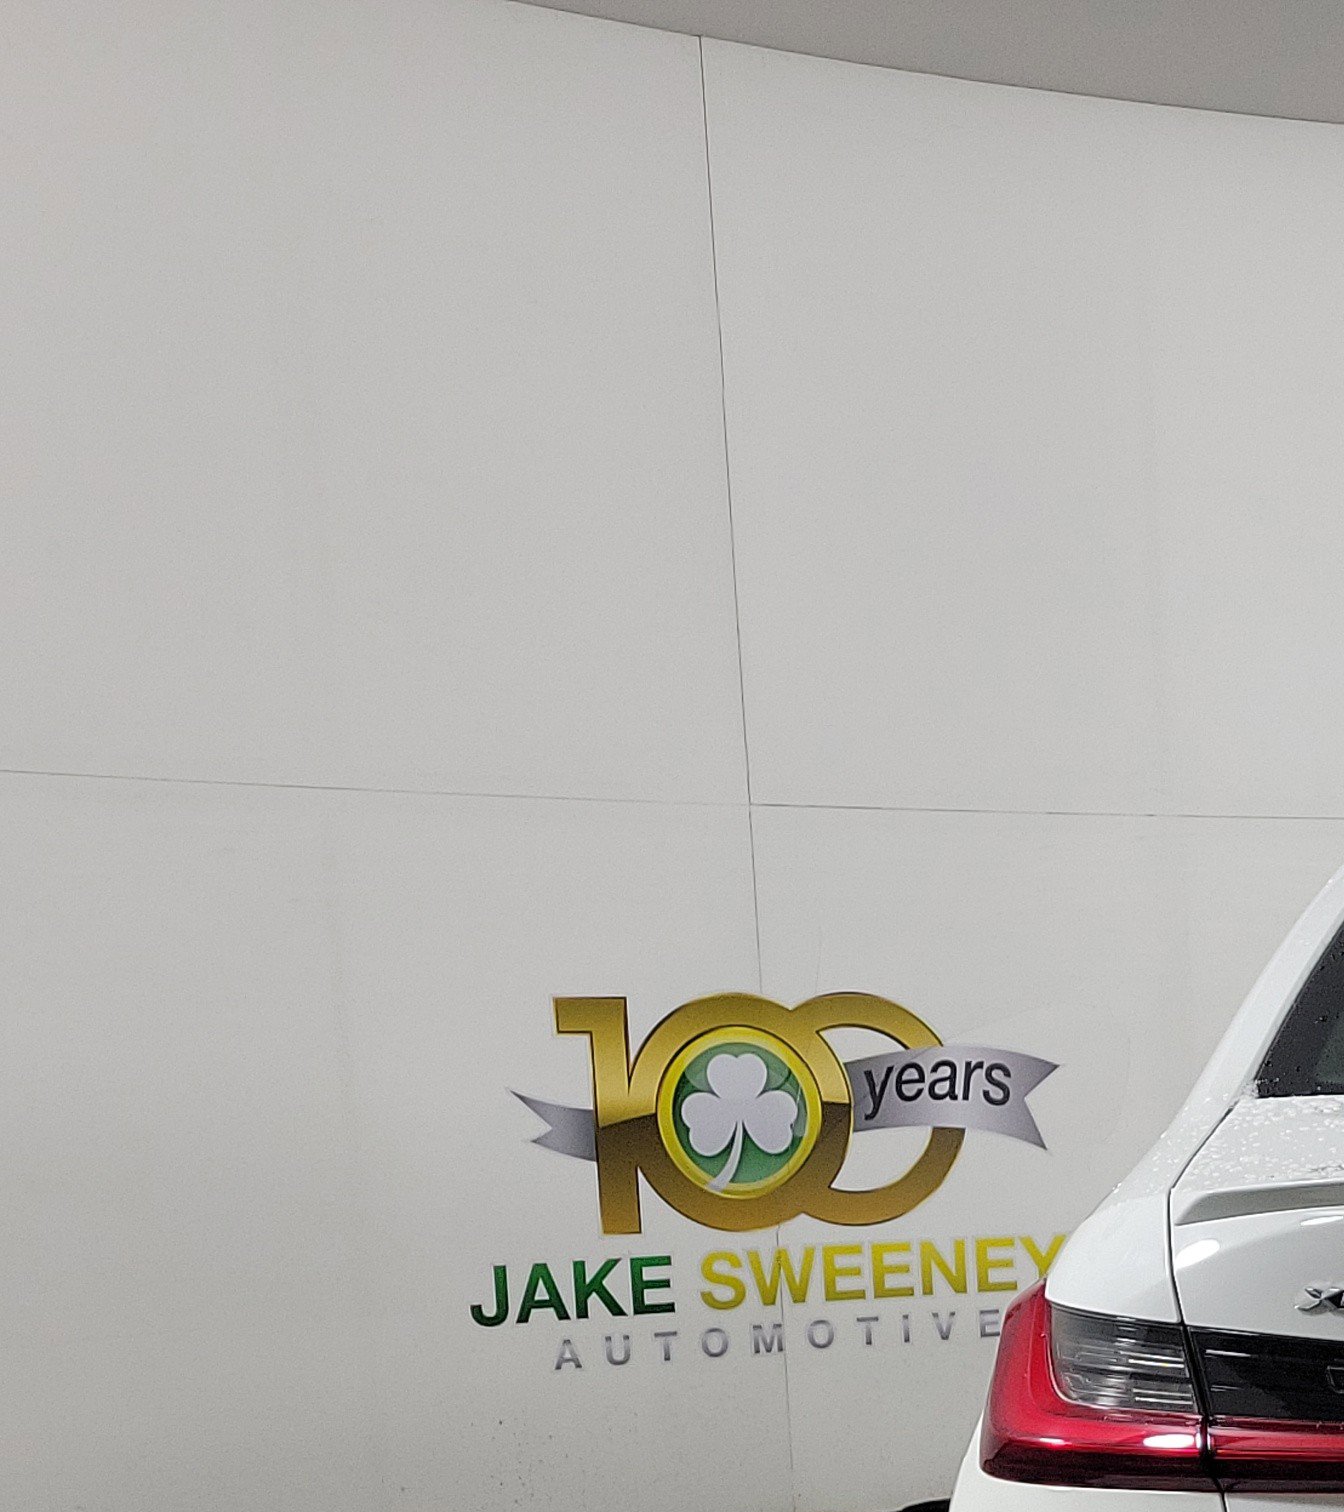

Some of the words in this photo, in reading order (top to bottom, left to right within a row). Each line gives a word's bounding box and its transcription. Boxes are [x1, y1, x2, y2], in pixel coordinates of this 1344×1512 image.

[553, 991, 966, 1235] 100
[863, 1058, 1012, 1119] years
[470, 1254, 676, 1328] JAKE
[700, 1233, 1066, 1311] SWEENEY
[553, 1310, 1000, 1371] AUTOMOTIVE
